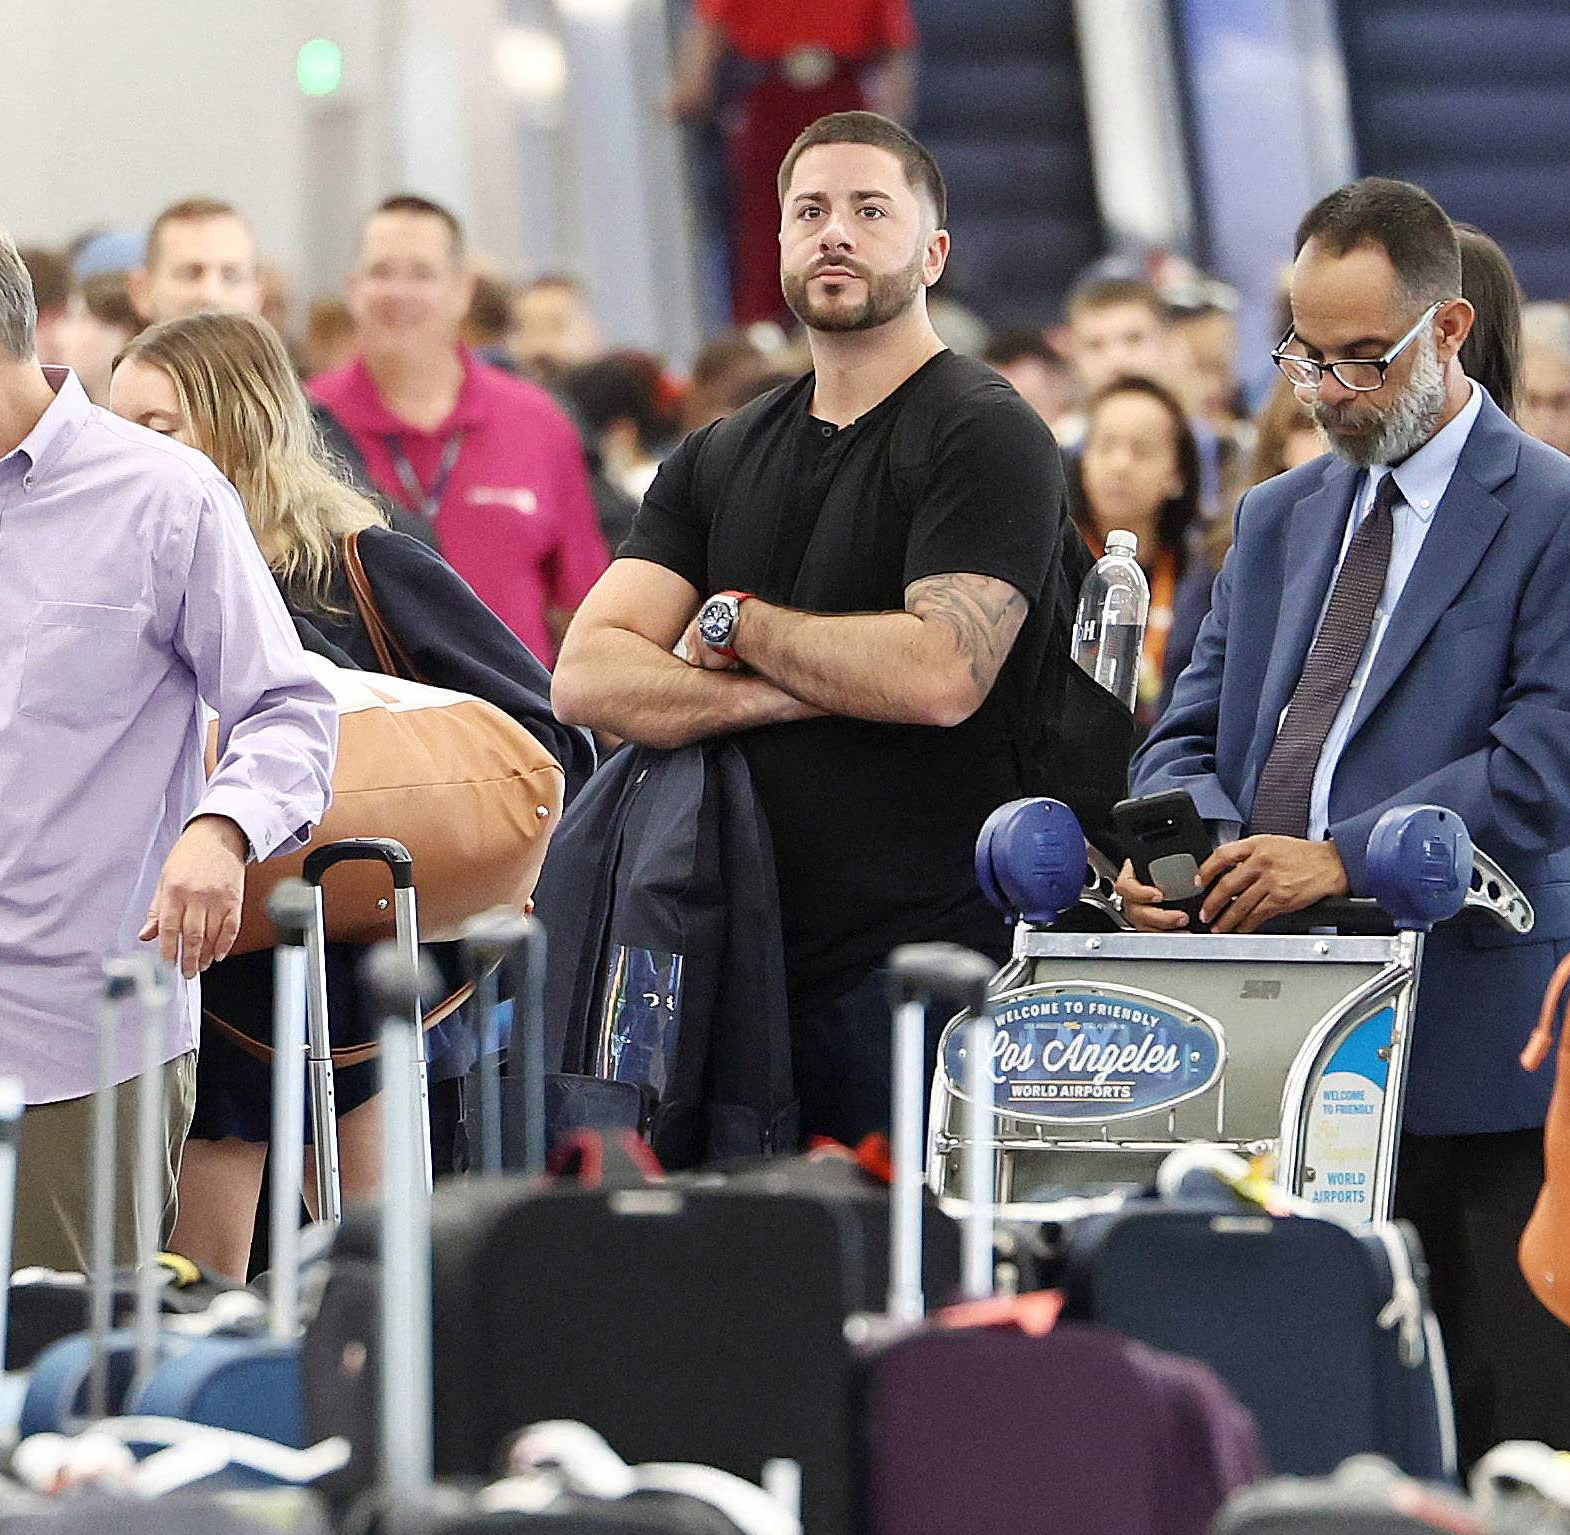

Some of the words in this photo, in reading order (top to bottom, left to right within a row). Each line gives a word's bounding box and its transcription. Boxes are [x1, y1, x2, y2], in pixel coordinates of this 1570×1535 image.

[995, 1001, 1059, 1027] WELCOME
[1065, 1001, 1083, 1014] TO
[1089, 1003, 1159, 1028] FRIENDLY
[989, 1030, 1034, 1084] Los
[1042, 1033, 1180, 1085] Angeles
[1011, 1085, 1058, 1098] WORLD
[1060, 1085, 1131, 1098] AIRPORTS
[1323, 1090, 1365, 1101] WELCOME
[1323, 1104, 1334, 1115] TO
[1335, 1104, 1375, 1115] FRIENDLY
[1327, 1172, 1366, 1185] WORLD
[1313, 1190, 1366, 1204] AIRPORTS
